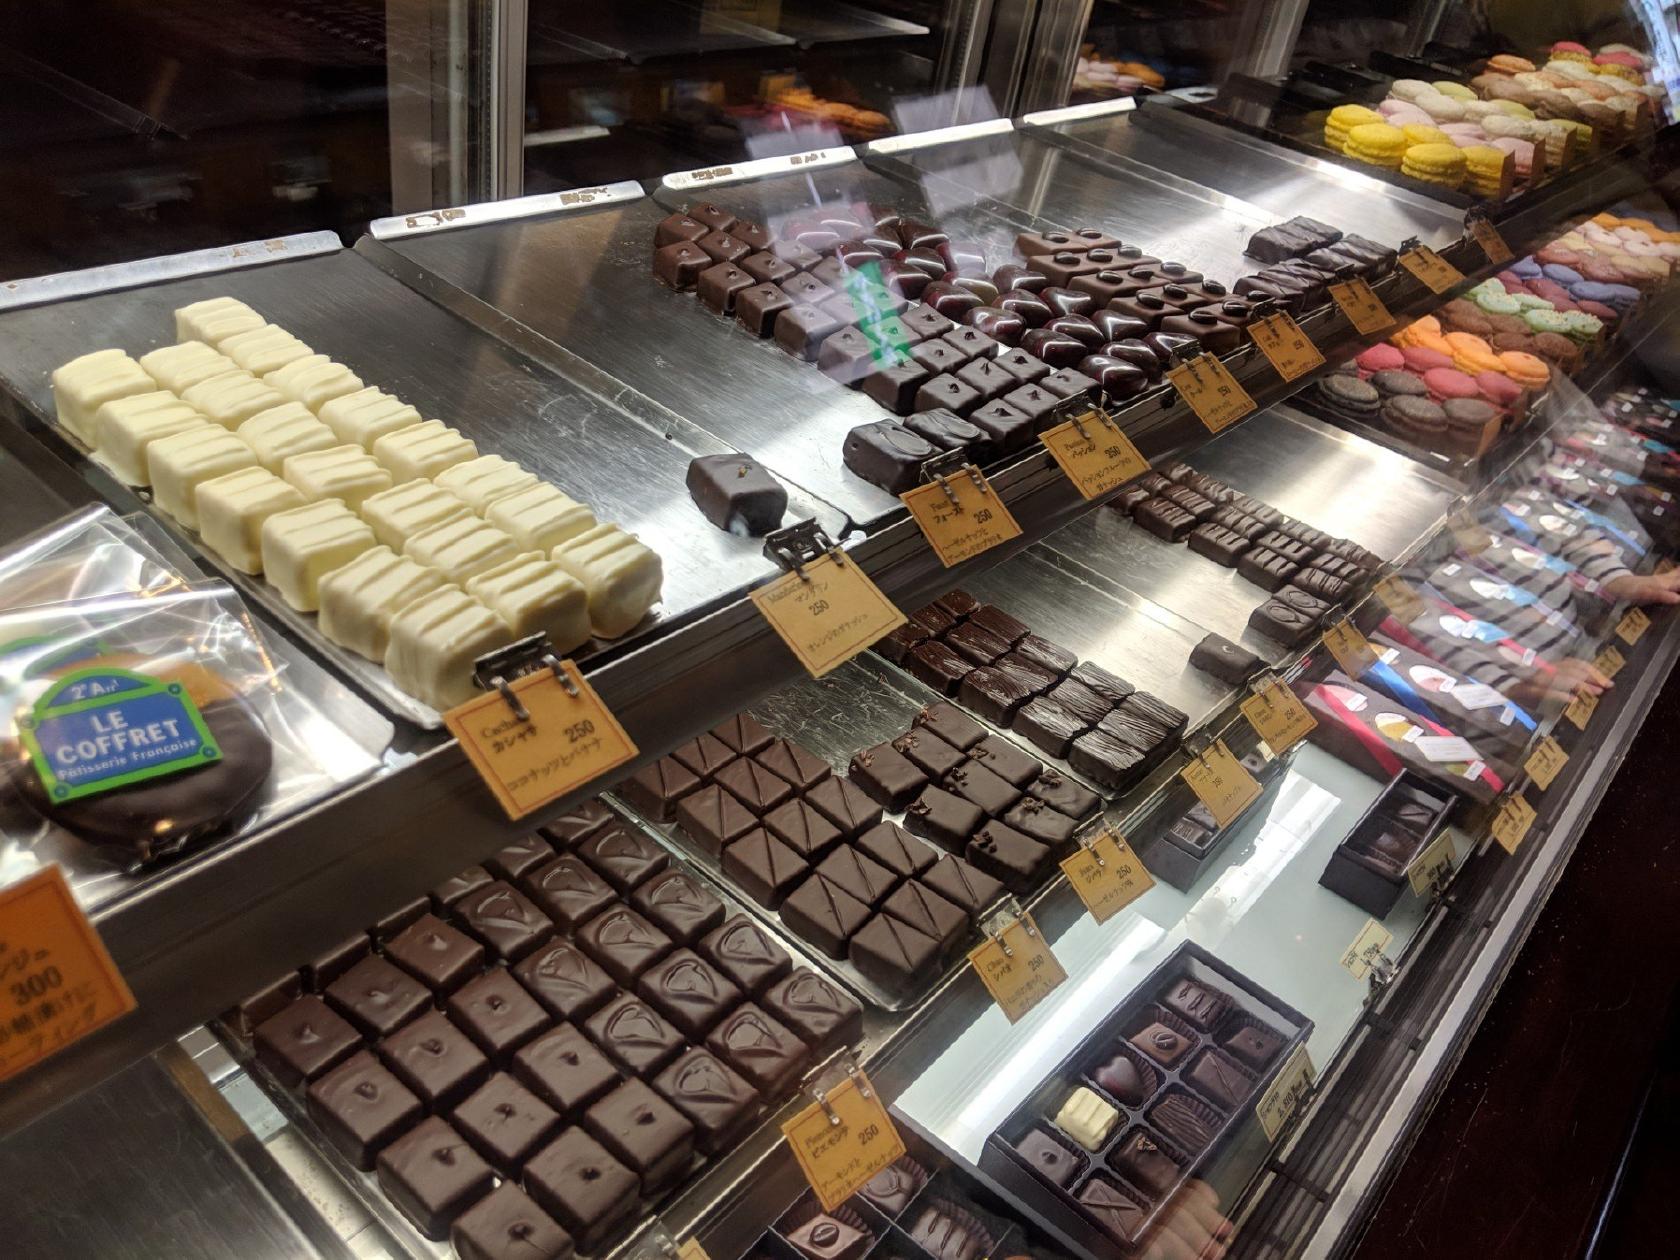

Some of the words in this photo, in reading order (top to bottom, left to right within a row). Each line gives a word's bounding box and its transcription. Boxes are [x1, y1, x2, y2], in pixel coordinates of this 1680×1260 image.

[1103, 445, 1121, 458] 250
[972, 508, 992, 524] 250
[808, 599, 829, 616] 250
[90, 710, 129, 734] LE
[563, 719, 594, 743] 250
[55, 718, 180, 765] COFFRET
[132, 737, 197, 762] Française
[1115, 864, 1131, 879] 250
[1027, 953, 1044, 971] 250
[9, 965, 63, 1006] 300
[857, 1123, 879, 1145] 250
